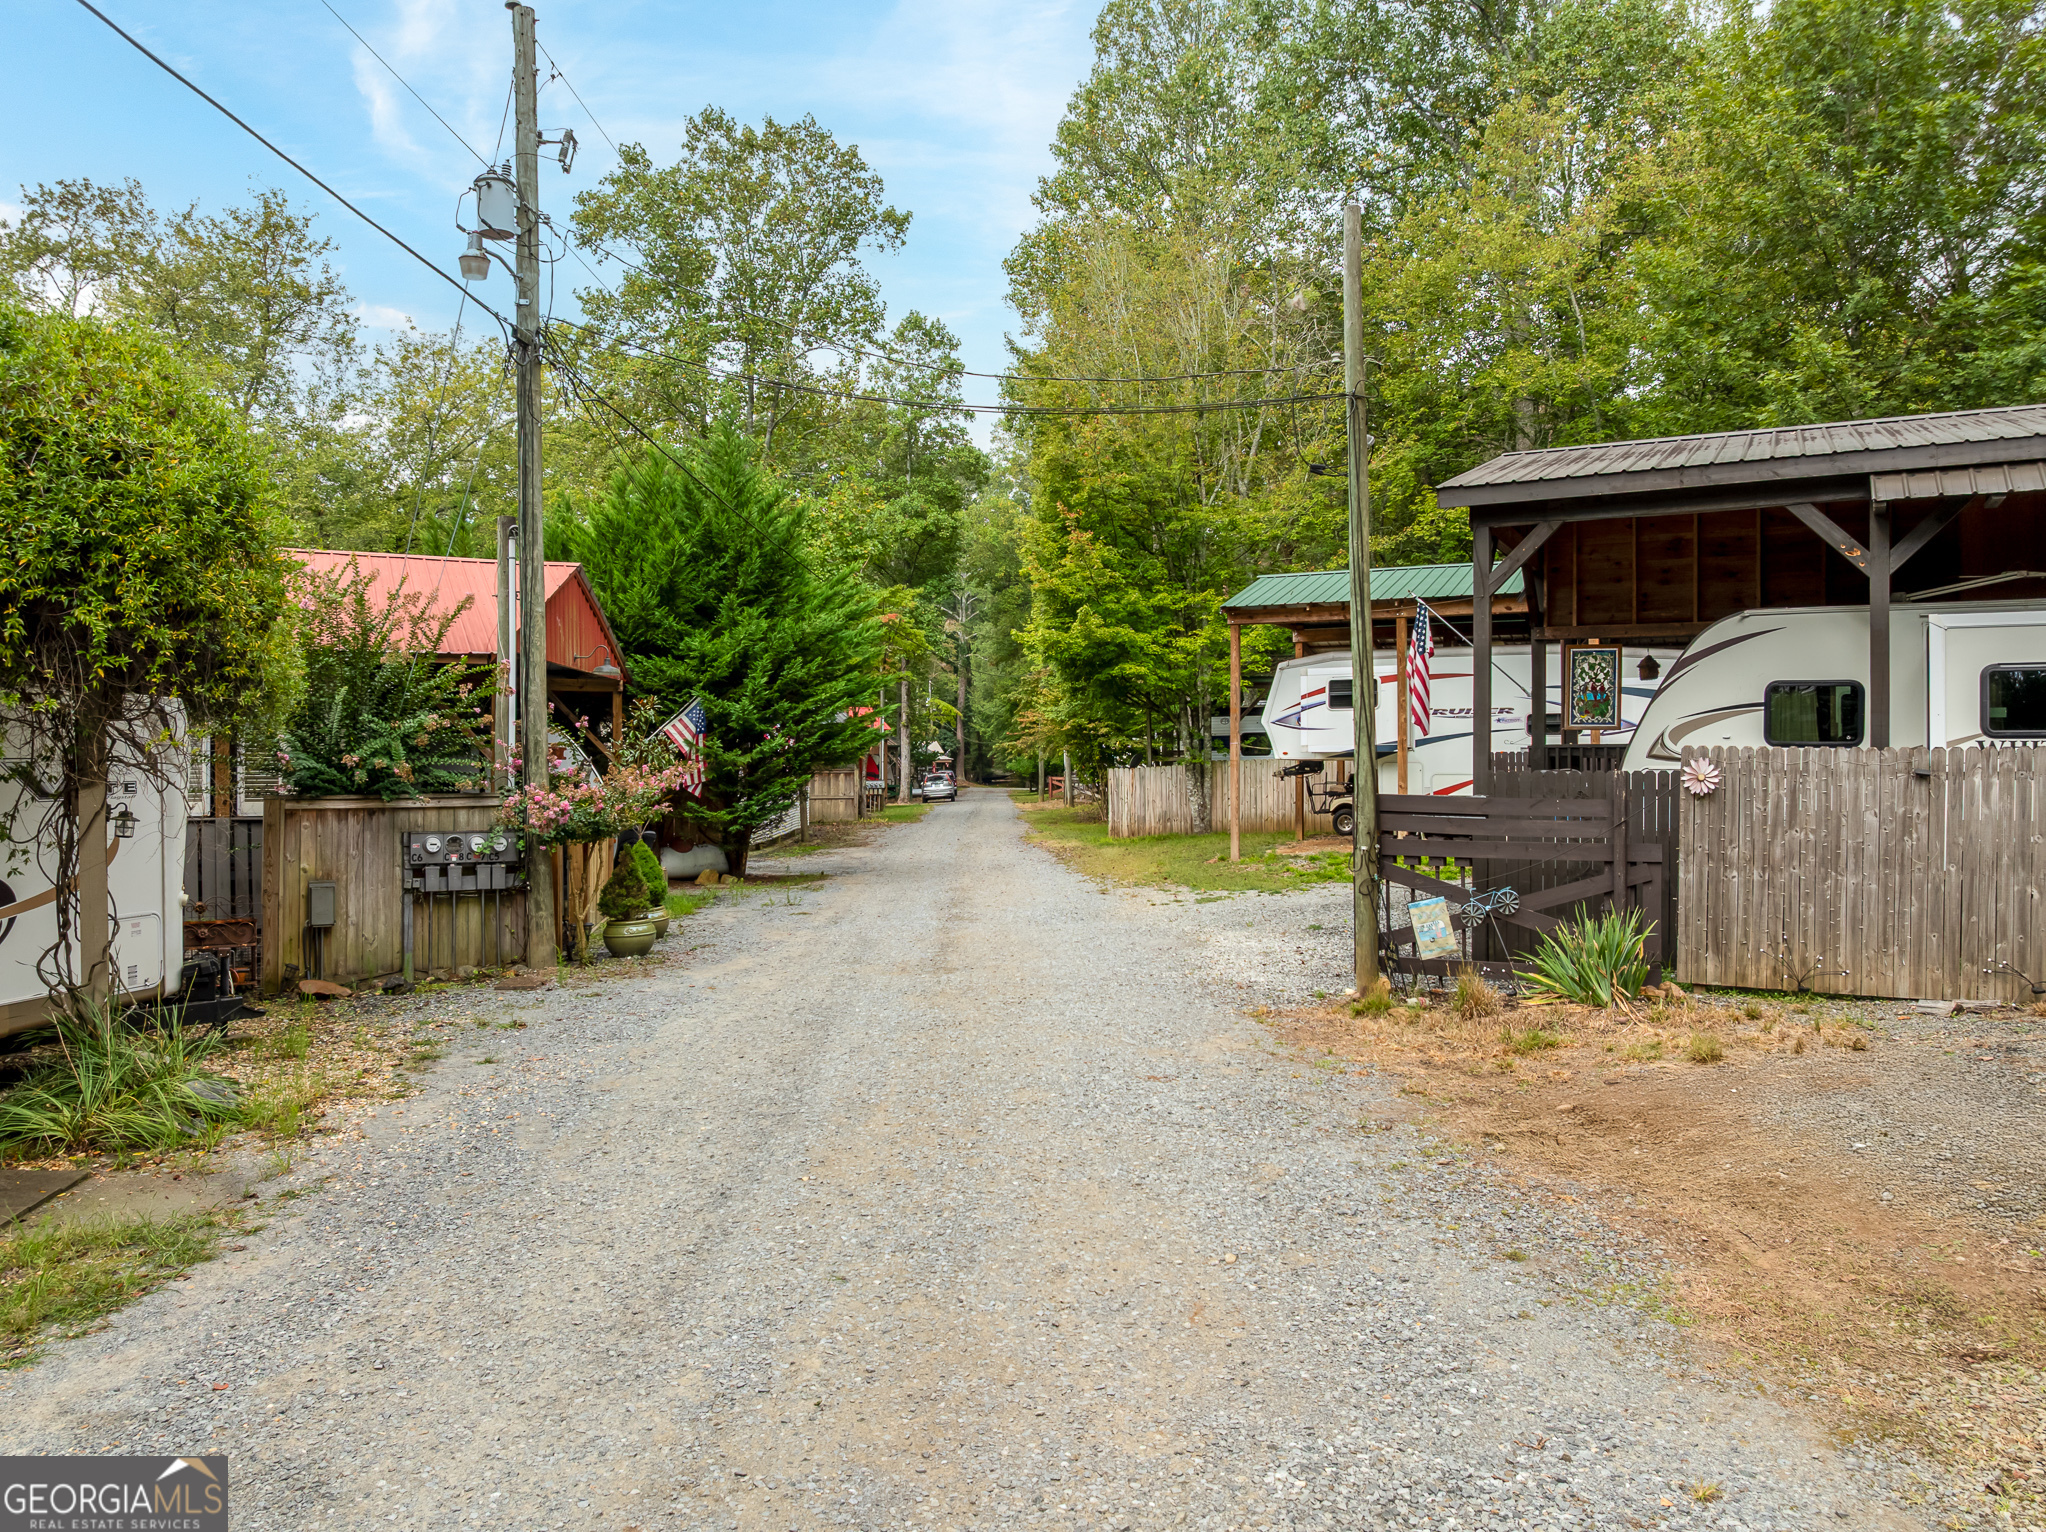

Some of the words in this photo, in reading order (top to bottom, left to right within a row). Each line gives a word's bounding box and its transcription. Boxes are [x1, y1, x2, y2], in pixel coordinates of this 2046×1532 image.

[1429, 707, 1515, 716] RUIER
[411, 853, 423, 862] C6
[488, 852, 500, 861] C5
